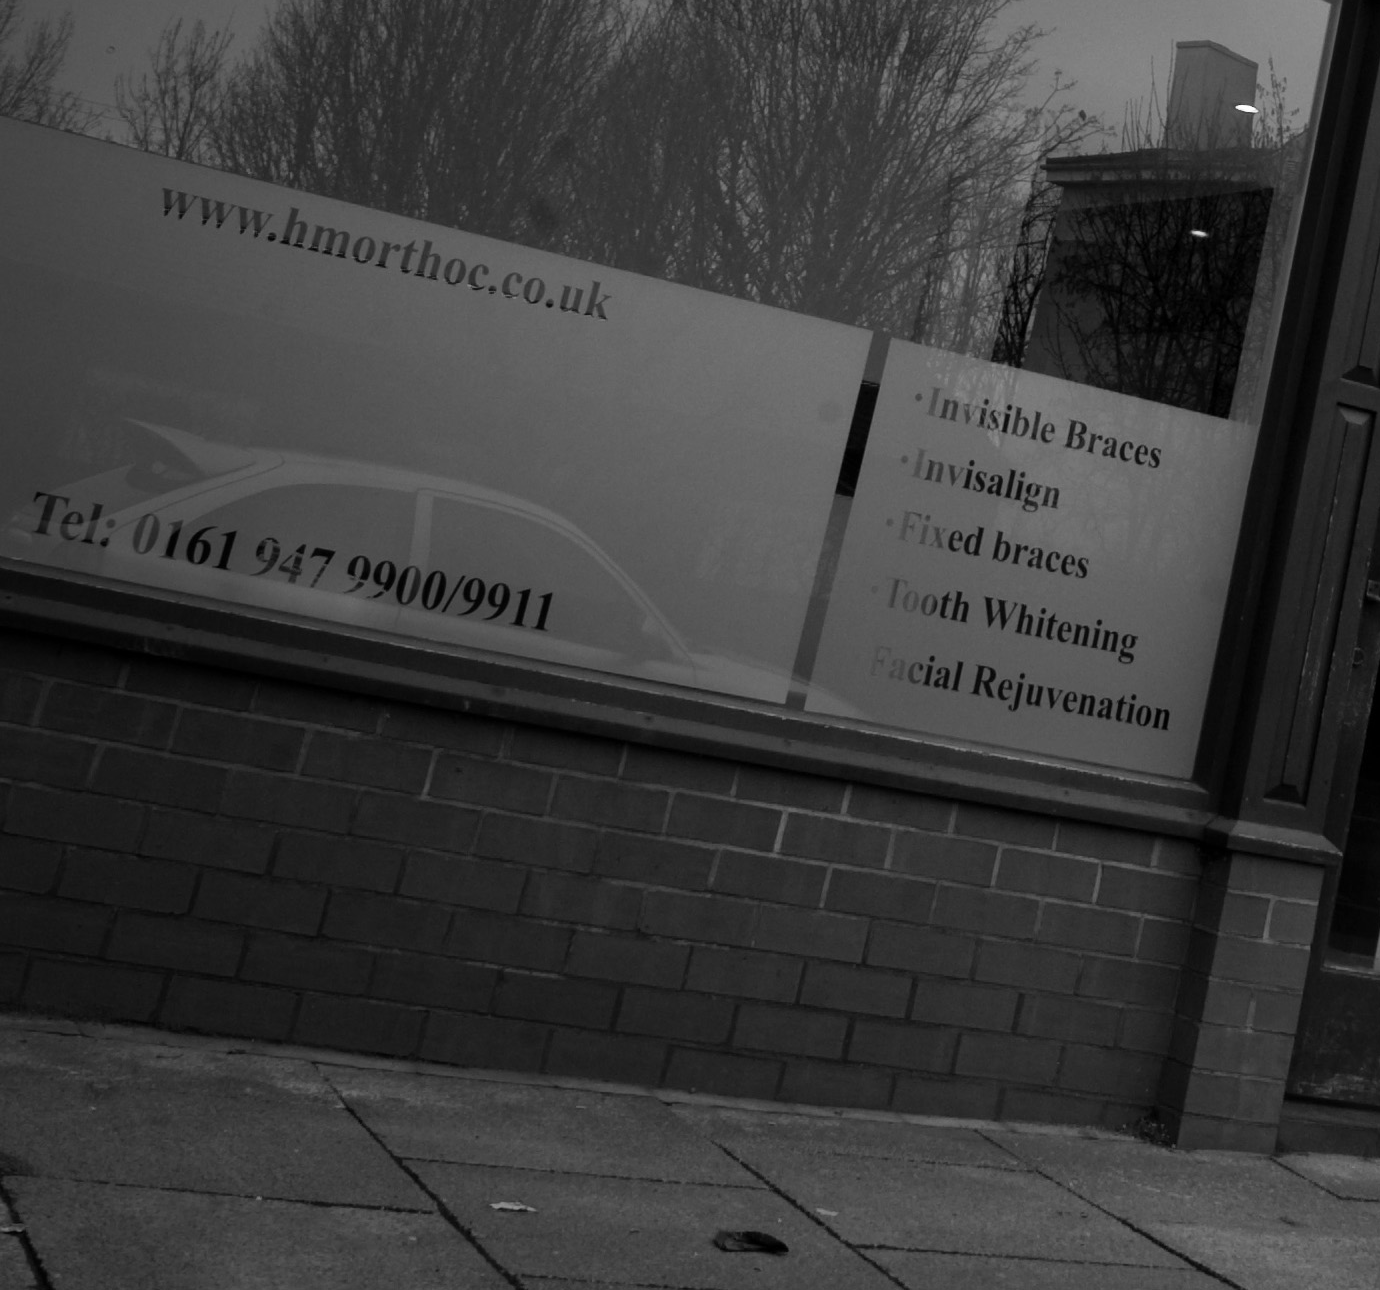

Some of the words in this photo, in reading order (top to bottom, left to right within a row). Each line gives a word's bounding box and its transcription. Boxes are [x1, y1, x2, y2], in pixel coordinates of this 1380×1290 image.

[161, 186, 613, 321] www.hmorthoc.co.uk
[926, 386, 1056, 443] Invisible
[1064, 418, 1164, 469] Braces
[911, 446, 1061, 514] Invisalign
[32, 490, 117, 549] Tel:
[131, 512, 240, 571] 0161
[250, 536, 336, 590] 947
[346, 554, 555, 632] 9900/9911
[898, 509, 985, 557] Fixed
[991, 530, 1091, 579] braces
[885, 576, 971, 624] Tooth
[982, 595, 1140, 665] Whitening
[868, 645, 965, 692] Facial
[969, 662, 1172, 731] Rejuvenation
